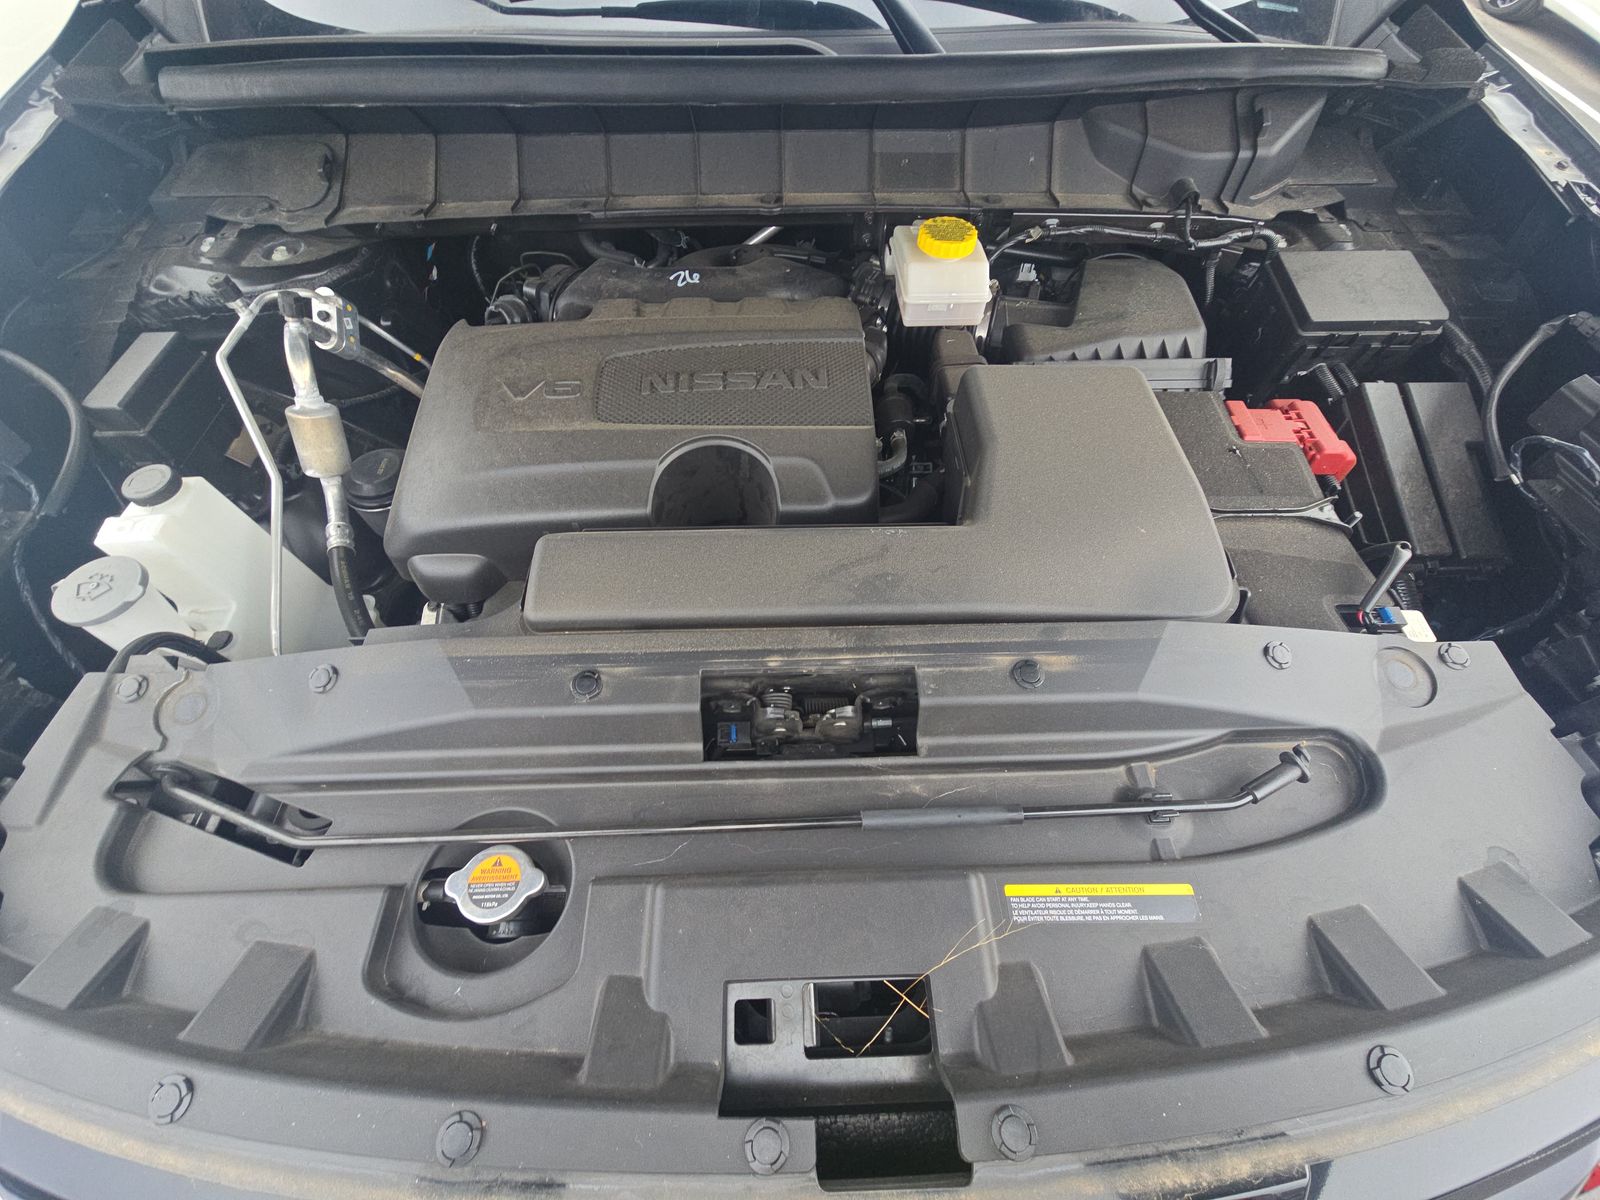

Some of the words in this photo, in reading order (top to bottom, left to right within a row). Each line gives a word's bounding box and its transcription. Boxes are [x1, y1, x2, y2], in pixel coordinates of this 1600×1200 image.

[669, 270, 700, 287] 26
[502, 379, 584, 400] V6
[641, 367, 830, 395] NISSAN
[470, 874, 518, 882] AVERTISSEMENT
